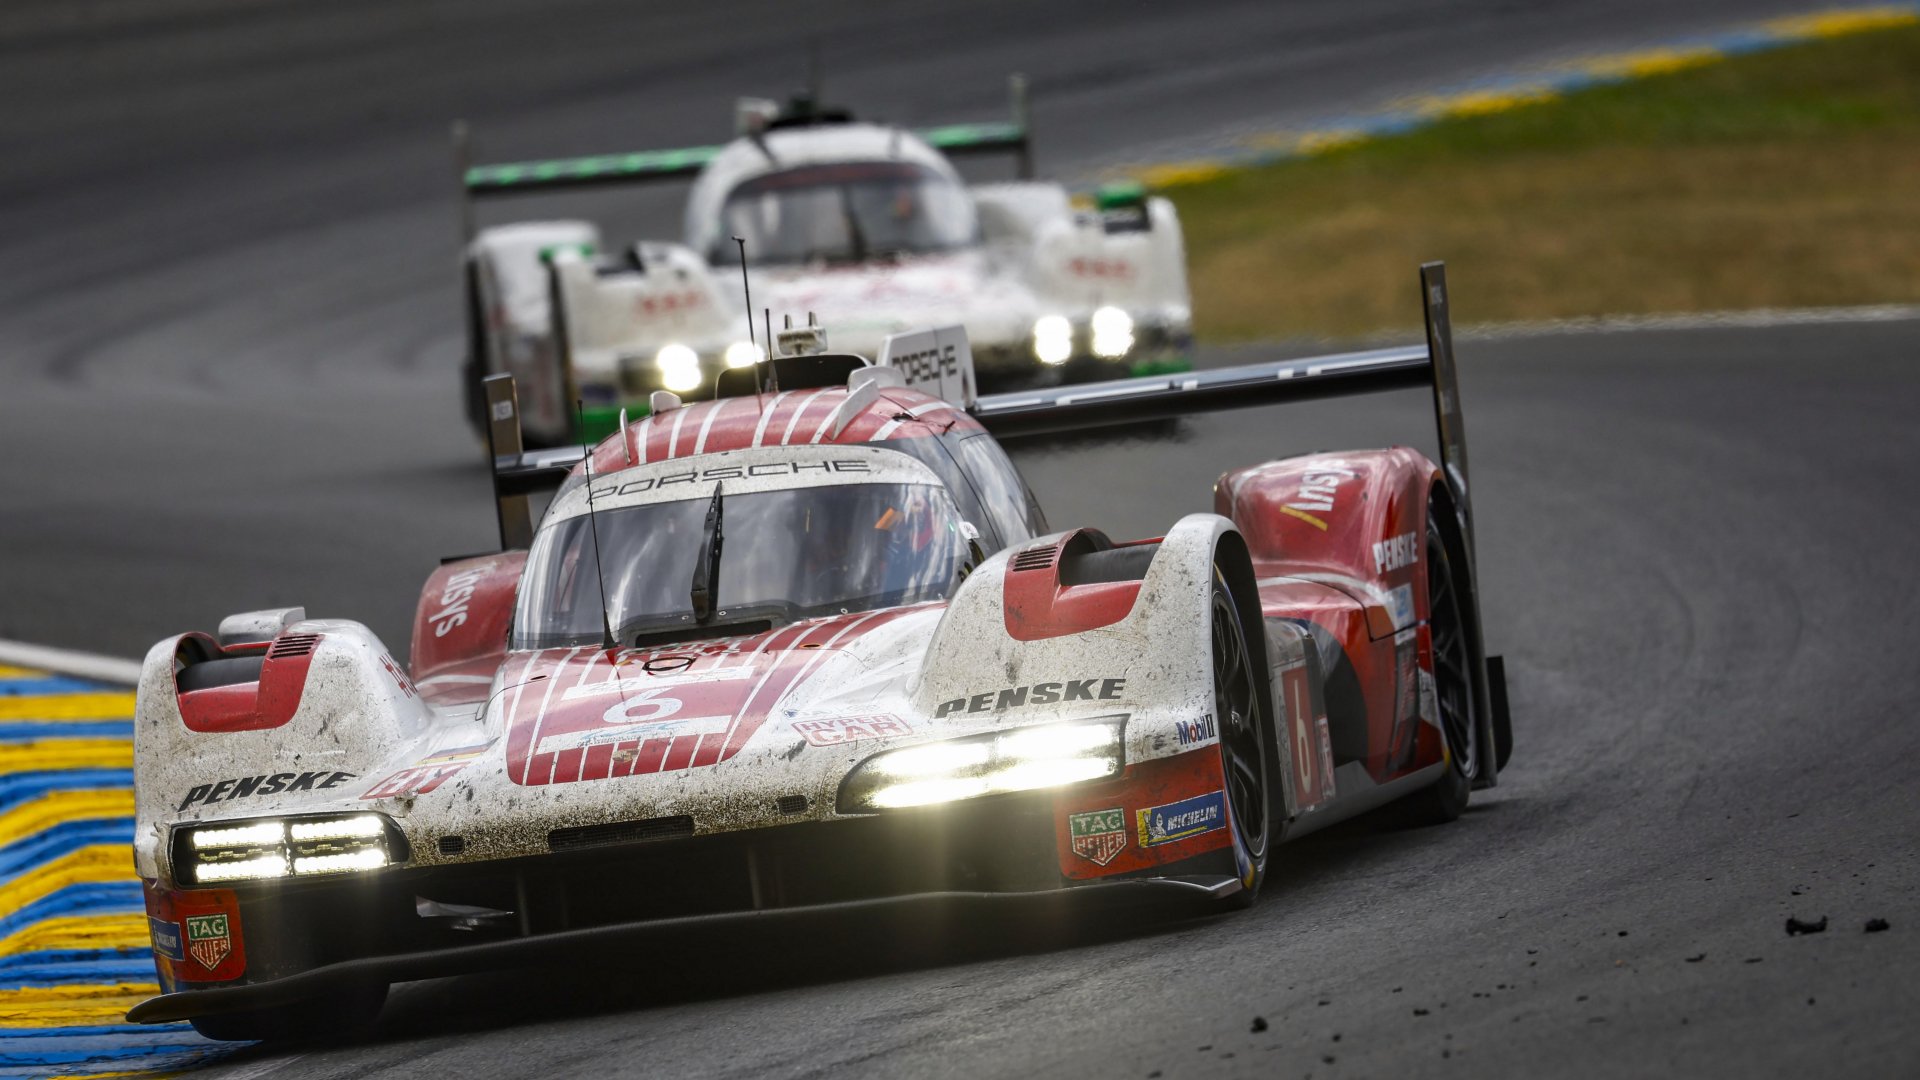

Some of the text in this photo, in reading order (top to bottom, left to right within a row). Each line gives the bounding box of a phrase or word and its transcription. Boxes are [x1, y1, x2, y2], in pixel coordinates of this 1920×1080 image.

[585, 460, 871, 504] PORSCHE
[603, 687, 683, 723] 6
[935, 678, 1127, 719] PENSKE
[800, 715, 893, 731] HYPER
[810, 722, 903, 741] CAR
[1294, 679, 1312, 794] 6
[177, 771, 357, 813] PENSKE
[1076, 813, 1121, 832] TAG
[1167, 804, 1218, 831] MICHELIN
[1076, 833, 1123, 861] HEUER
[190, 919, 224, 937] TAG
[192, 940, 228, 965] HEUER
